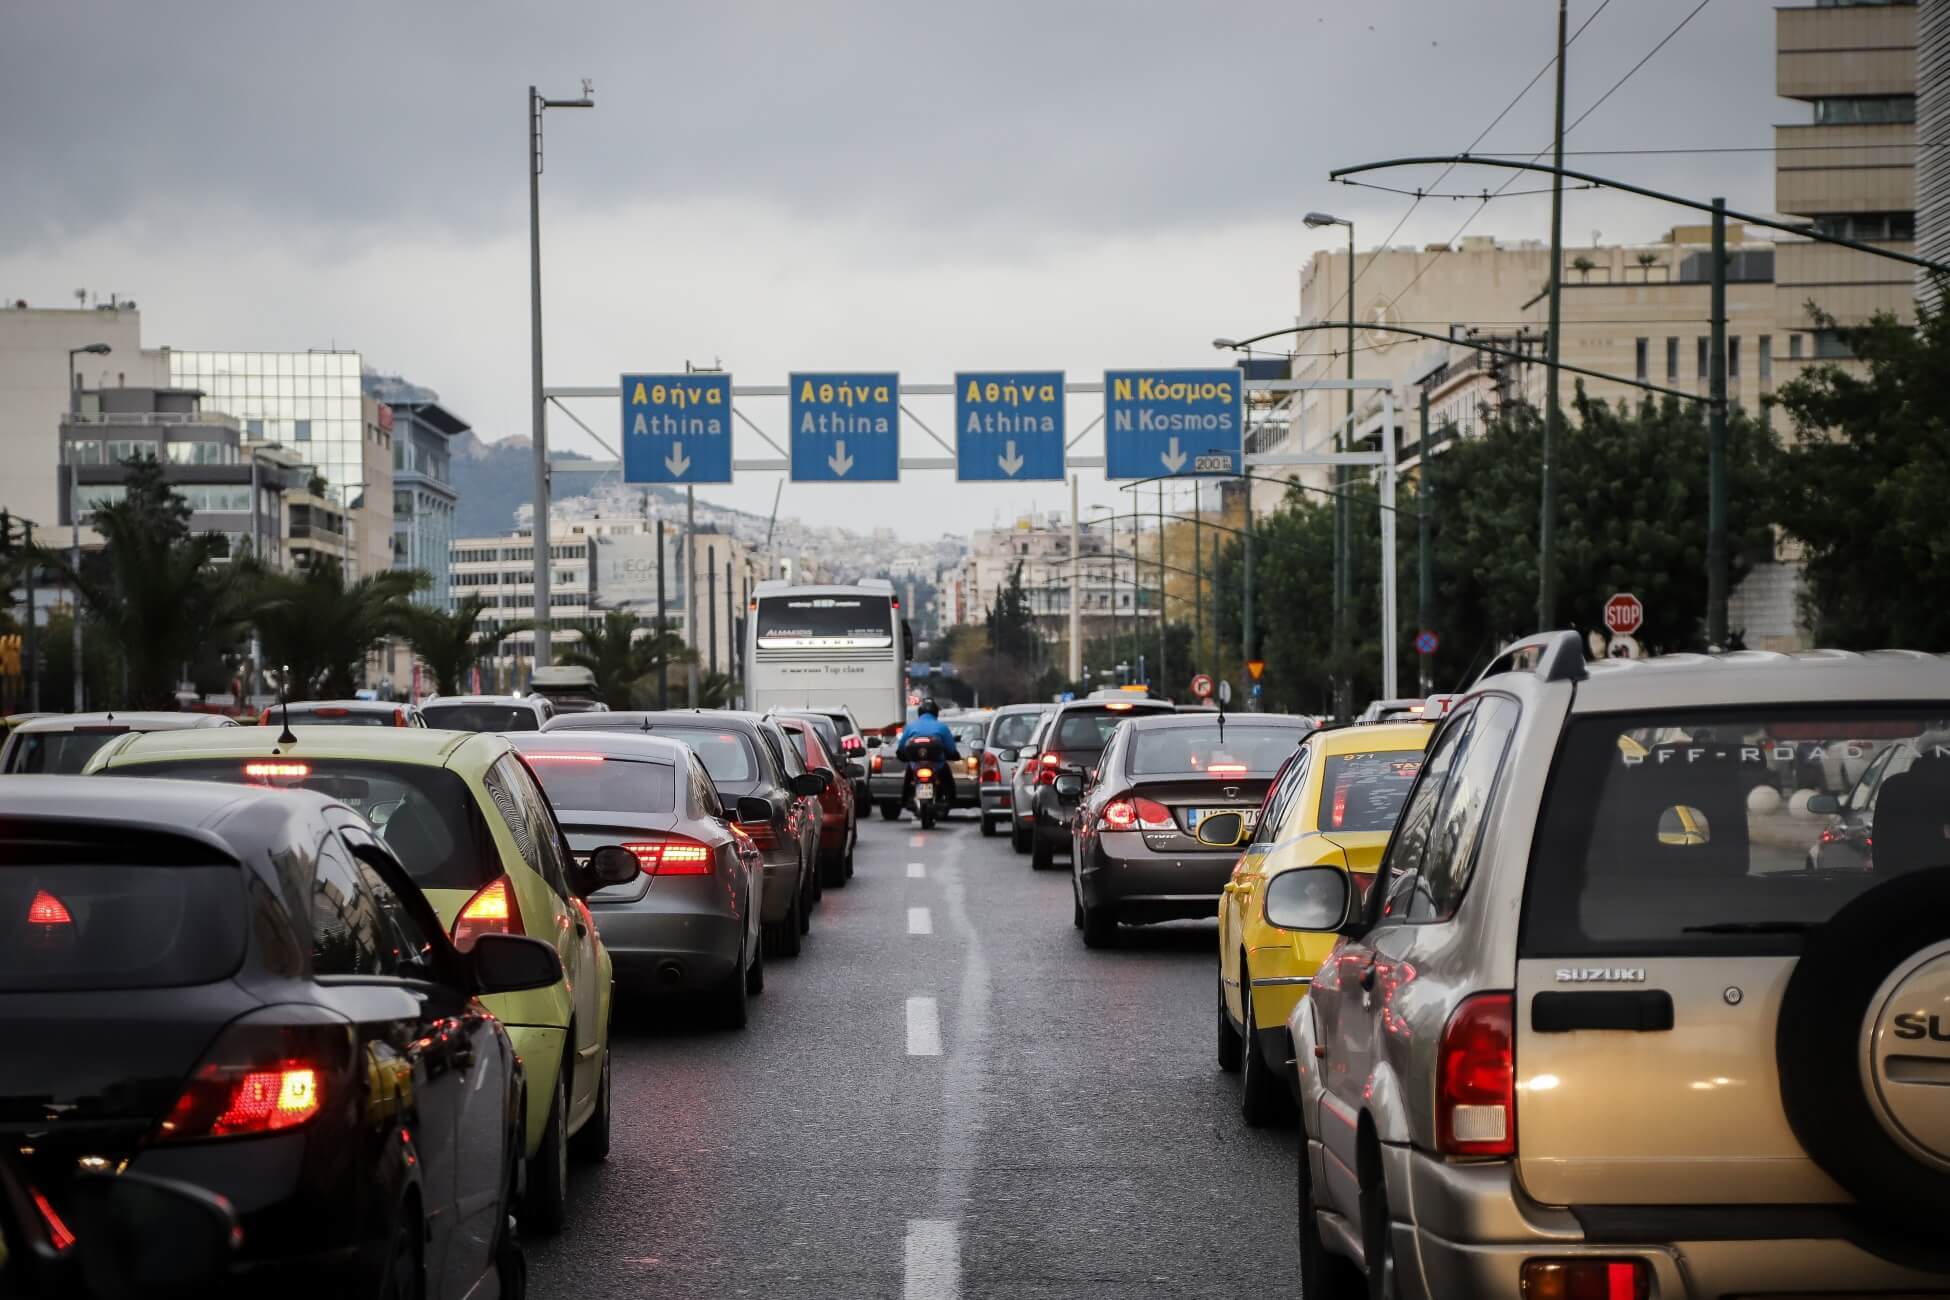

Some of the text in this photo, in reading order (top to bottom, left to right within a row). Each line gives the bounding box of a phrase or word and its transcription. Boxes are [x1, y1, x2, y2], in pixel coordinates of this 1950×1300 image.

[632, 382, 721, 409] Αθήνα
[800, 381, 888, 407] Αθήνα
[966, 379, 1054, 406] Αθήνα
[1138, 379, 1233, 404] Κόσμος
[633, 414, 721, 435] Athina
[801, 411, 888, 432] Athina
[967, 411, 1054, 433] Athina
[1138, 409, 1233, 431] Kosmos
[1608, 604, 1640, 625] STOP
[1623, 747, 1863, 765] OFF-ROAD
[1556, 967, 1646, 982] SUZUKI
